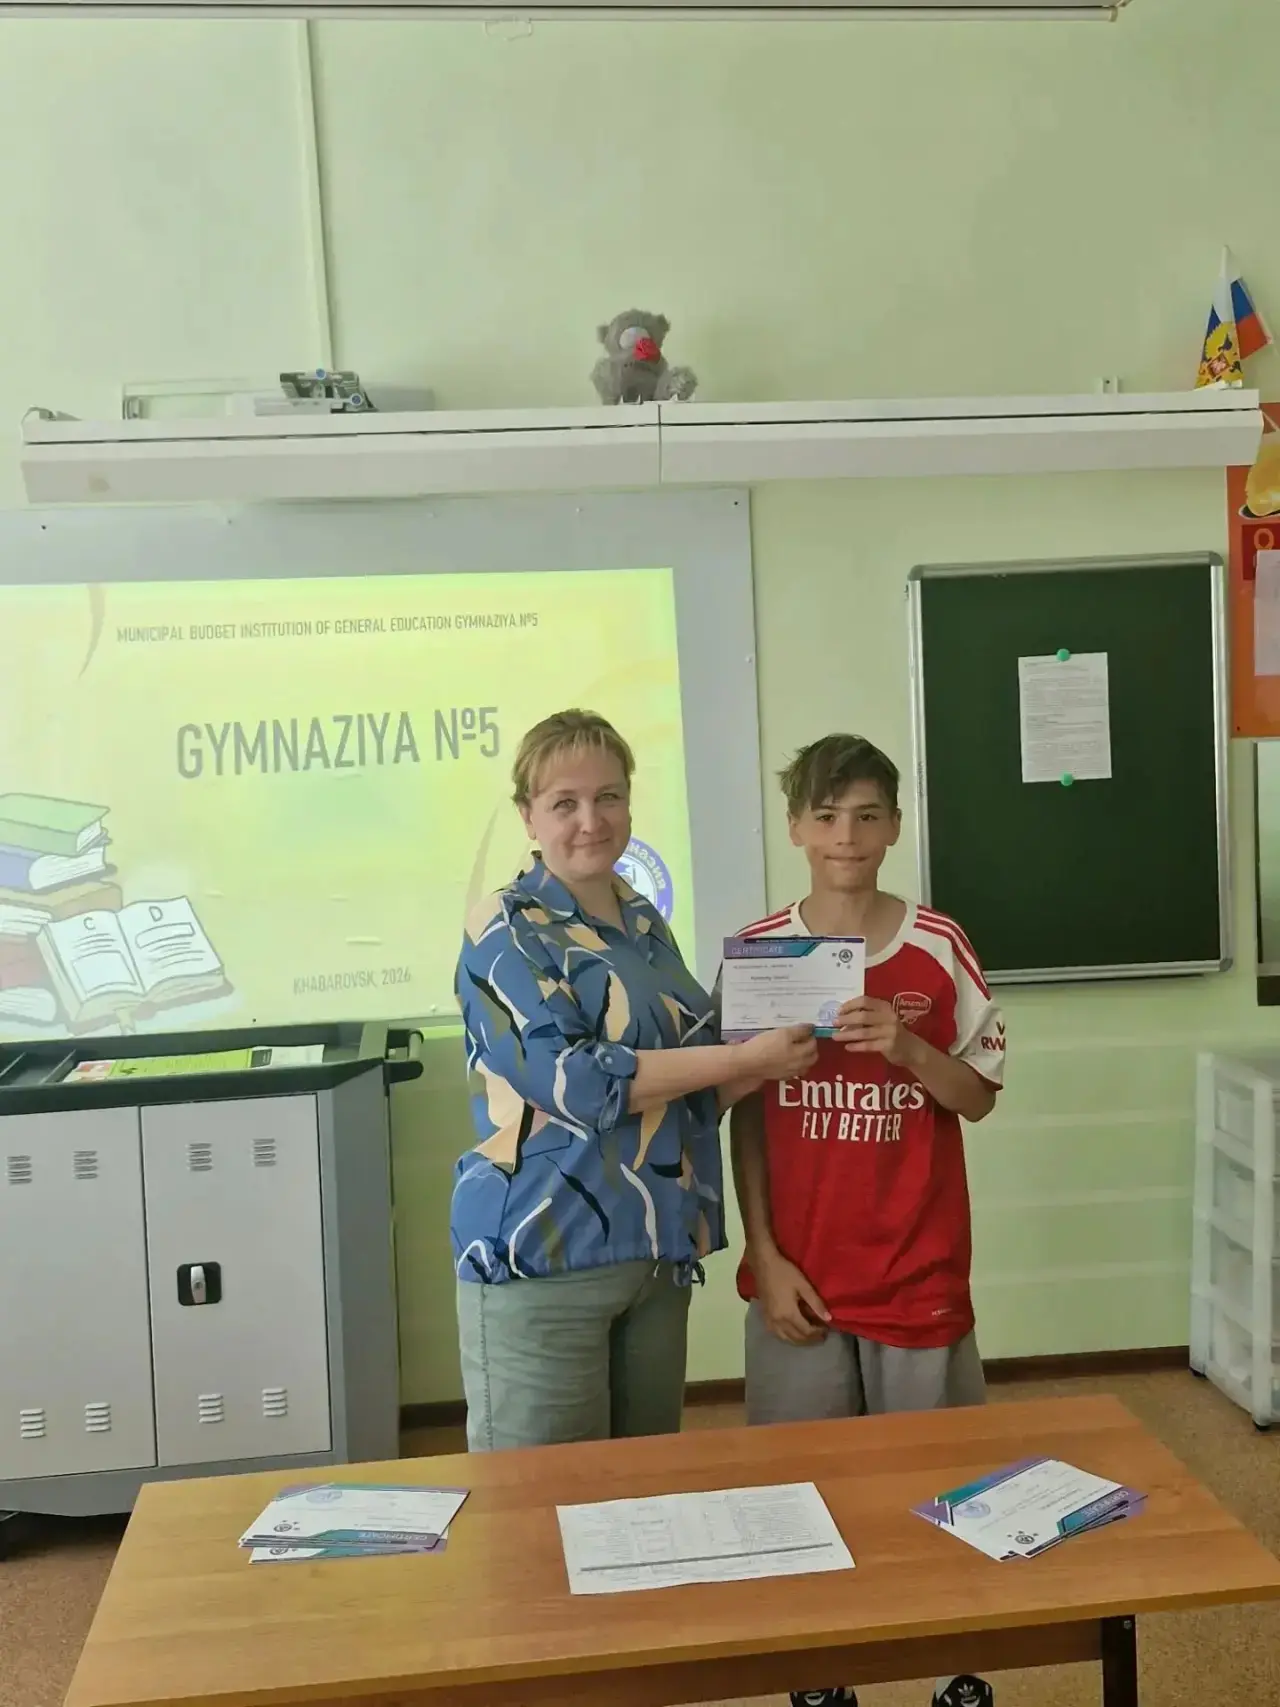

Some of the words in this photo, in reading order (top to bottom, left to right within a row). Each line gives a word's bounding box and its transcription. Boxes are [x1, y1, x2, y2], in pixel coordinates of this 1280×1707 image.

[116, 626, 185, 642] MUNICIPAL
[190, 624, 236, 640] BUDGET
[240, 621, 312, 638] INSTITUTION
[316, 620, 330, 635] OF
[334, 618, 386, 634] GENERAL
[391, 616, 451, 632] EDUCATION
[455, 613, 516, 629] GYMNAZIYA
[177, 711, 420, 779] GYMNAZIYA
[83, 916, 97, 931] C
[148, 905, 164, 922] D
[779, 1074, 925, 1111] Emirates
[802, 1111, 832, 1139] FLY
[838, 1112, 902, 1143] BETTER
